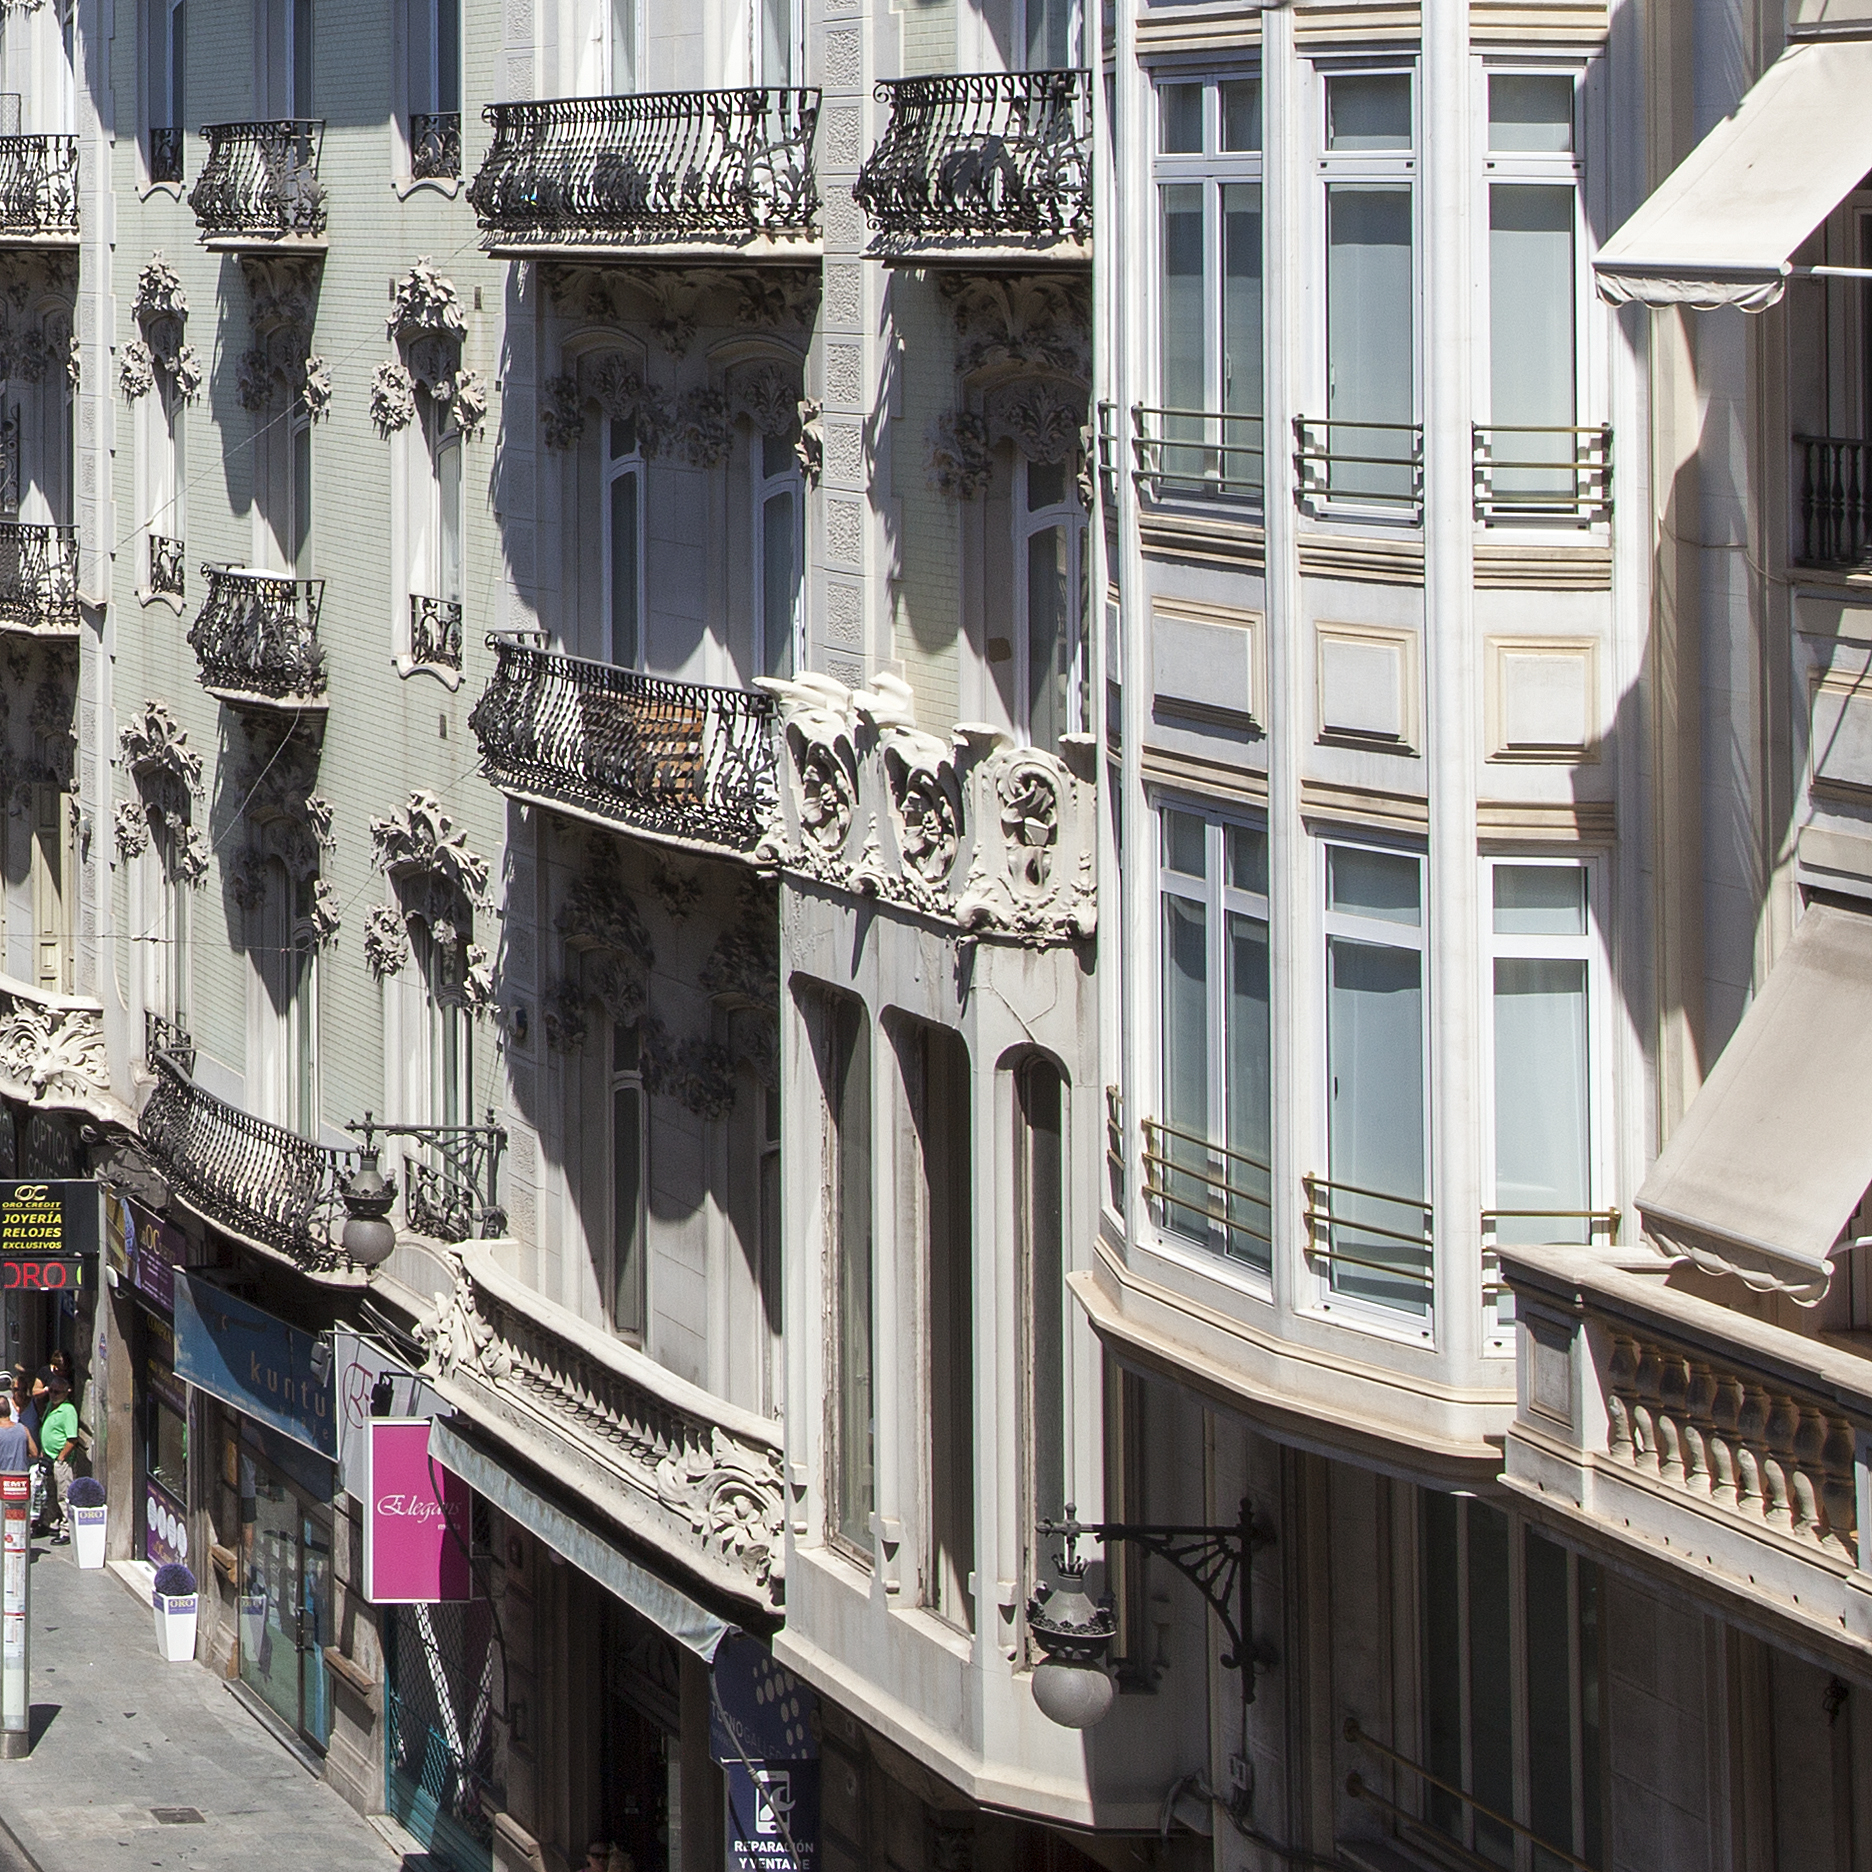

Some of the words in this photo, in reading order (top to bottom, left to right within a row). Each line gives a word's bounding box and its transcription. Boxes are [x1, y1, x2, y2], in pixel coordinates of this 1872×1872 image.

[32, 1115, 70, 1169] OPTICA
[2, 1211, 62, 1224] JOYERÍA
[2, 1228, 62, 1238] RELOJES
[2, 1241, 62, 1249] EXCLUSIVOS
[3, 1261, 67, 1288] ORO
[79, 1511, 103, 1519] ORO
[170, 1599, 195, 1607] ORO
[734, 1840, 814, 1853] REPARACÓN
[739, 1858, 748, 1870] Y
[749, 1858, 791, 1870] VENTA
